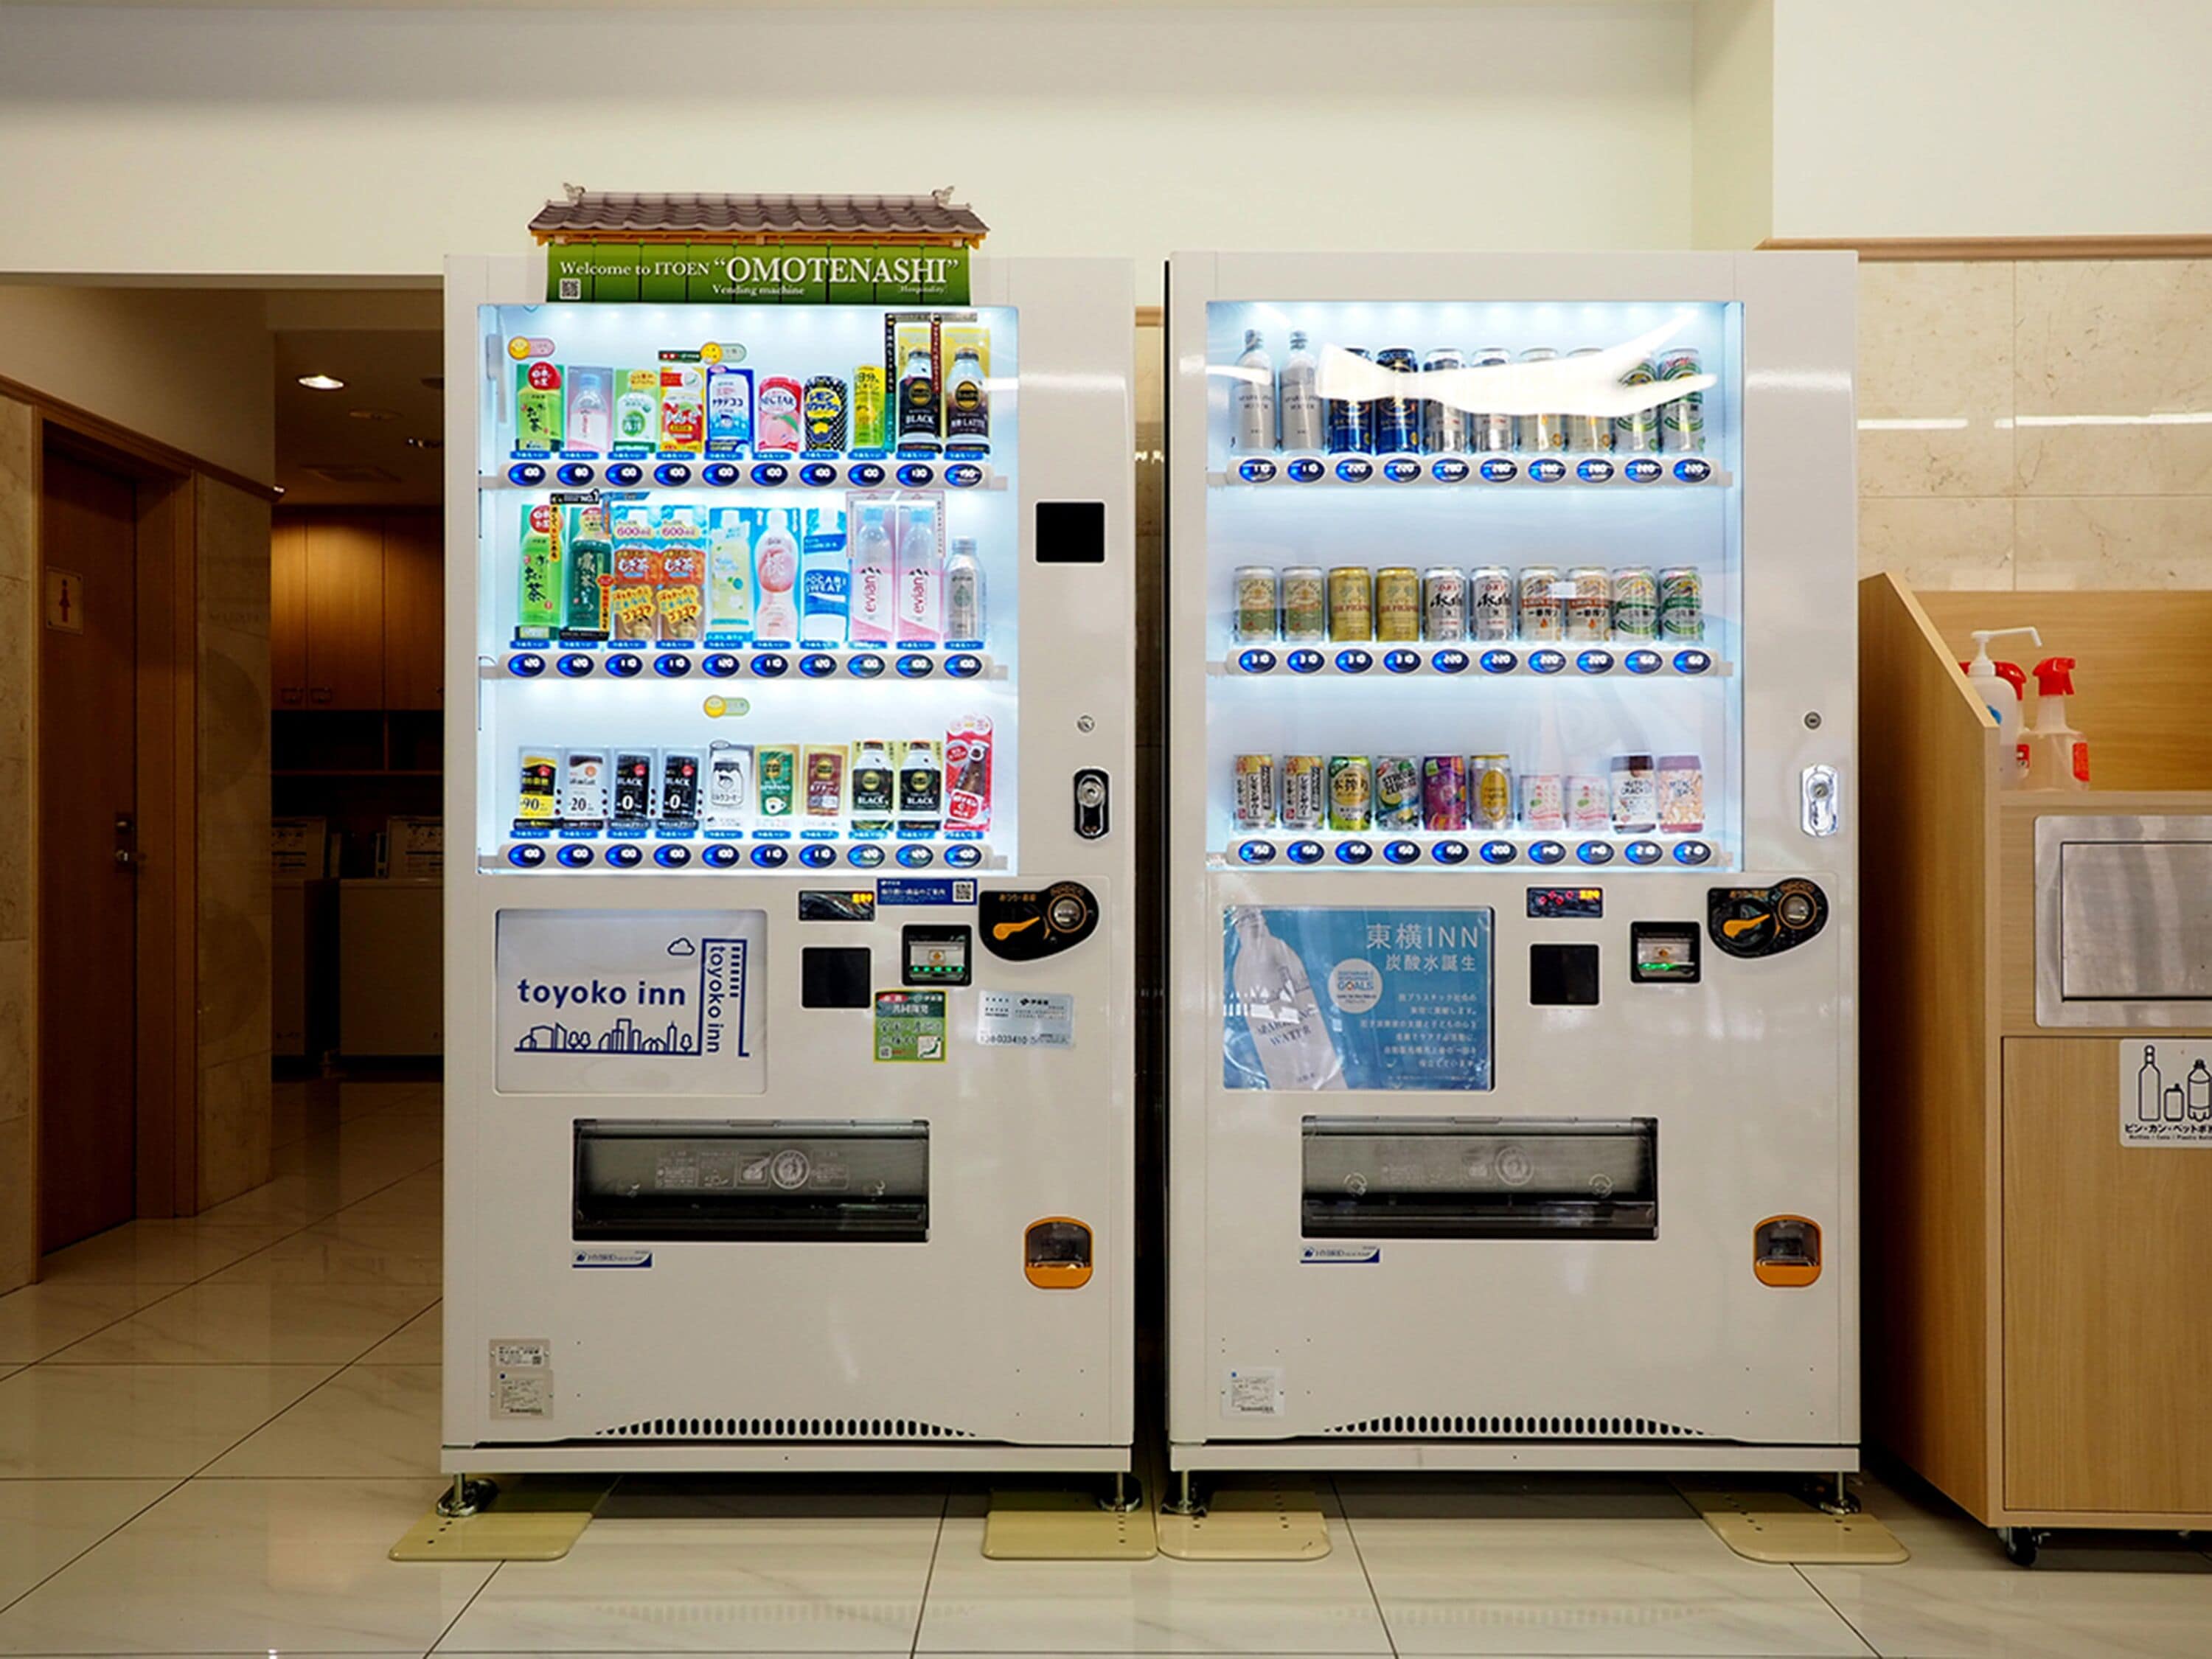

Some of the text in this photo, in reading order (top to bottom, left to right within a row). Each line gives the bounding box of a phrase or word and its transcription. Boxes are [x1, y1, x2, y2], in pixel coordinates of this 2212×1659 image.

[560, 261, 631, 275] Welcome
[636, 263, 650, 275] to
[654, 262, 709, 276] ITOEN
[712, 285, 804, 296] Vending machine
[905, 414, 935, 425] BLACK
[864, 574, 877, 613] evian
[914, 575, 925, 614] evian
[1366, 924, 1478, 950] 東横INN
[517, 979, 686, 1009] toyoko inn
[706, 946, 726, 1053] toyoko inn
